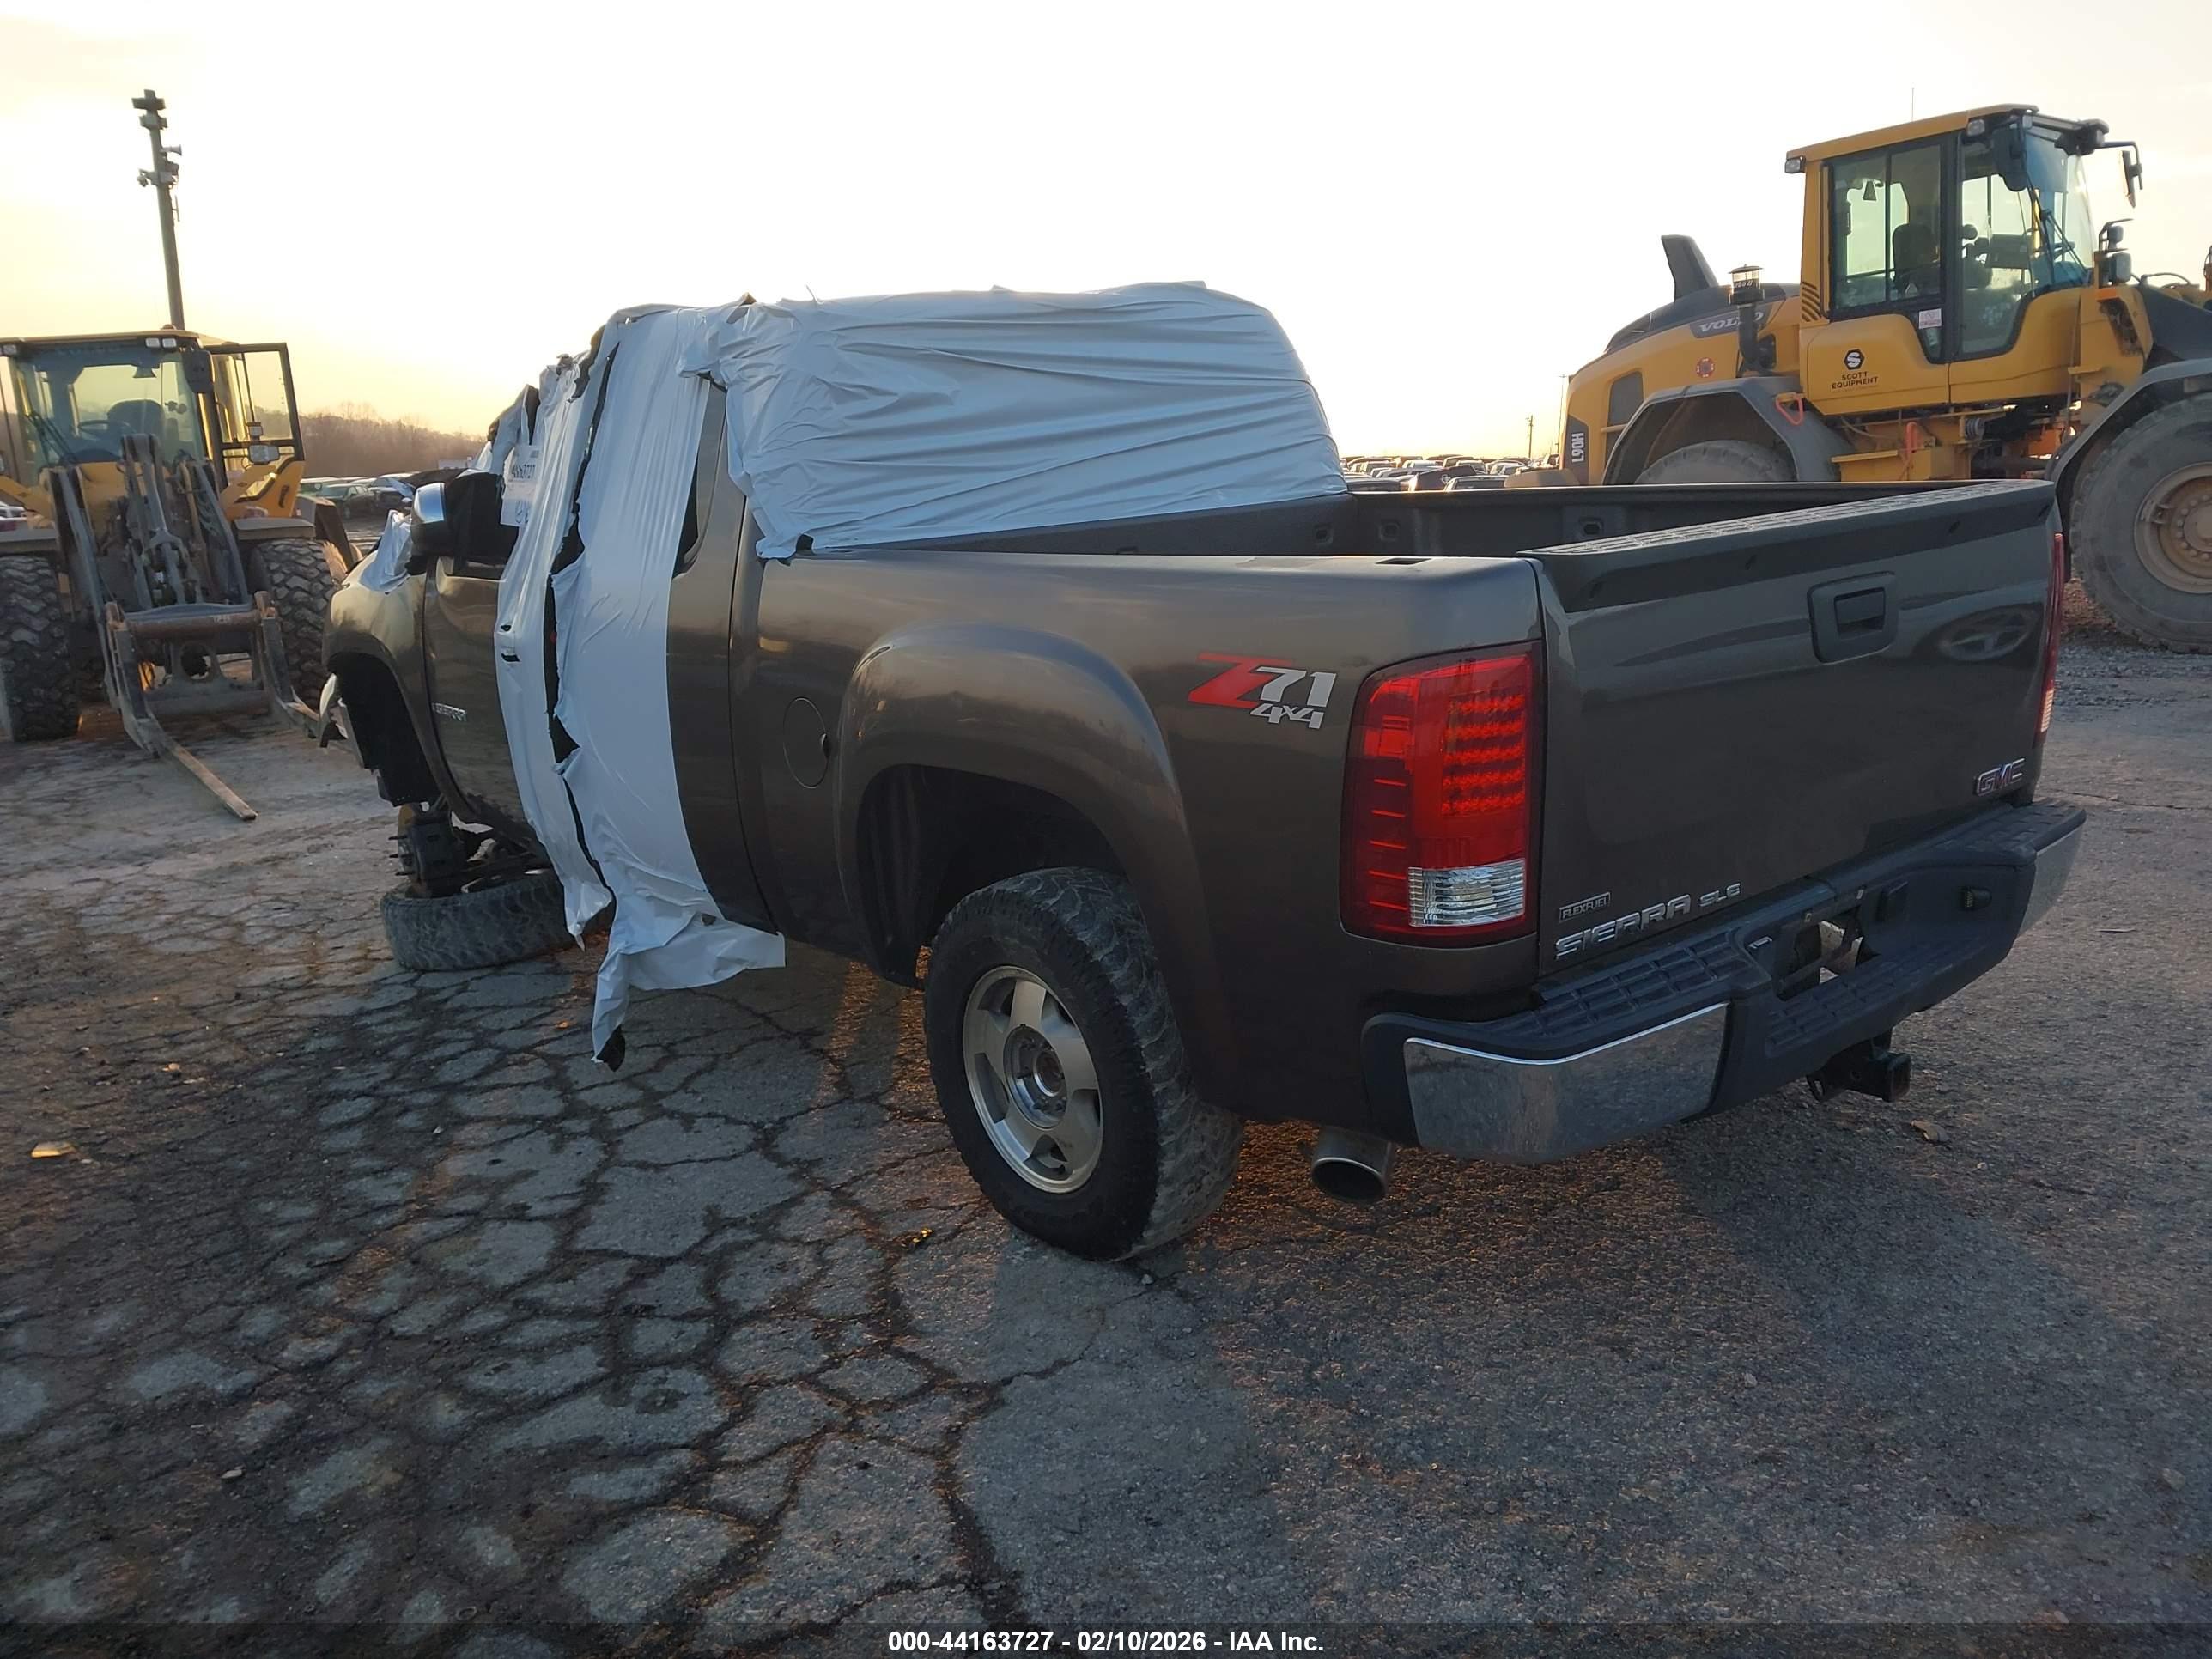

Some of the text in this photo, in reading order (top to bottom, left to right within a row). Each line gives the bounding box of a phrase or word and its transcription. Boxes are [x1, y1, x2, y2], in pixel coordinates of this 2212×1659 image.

[1832, 376, 1879, 389] EQUIPMENT
[1841, 371, 1869, 381] SCOTT
[1571, 432, 1584, 463] L90H
[1188, 652, 1337, 709] Z71
[1562, 896, 1609, 918] FLEXFUEL
[1555, 882, 1741, 959] SIERRA SLE
